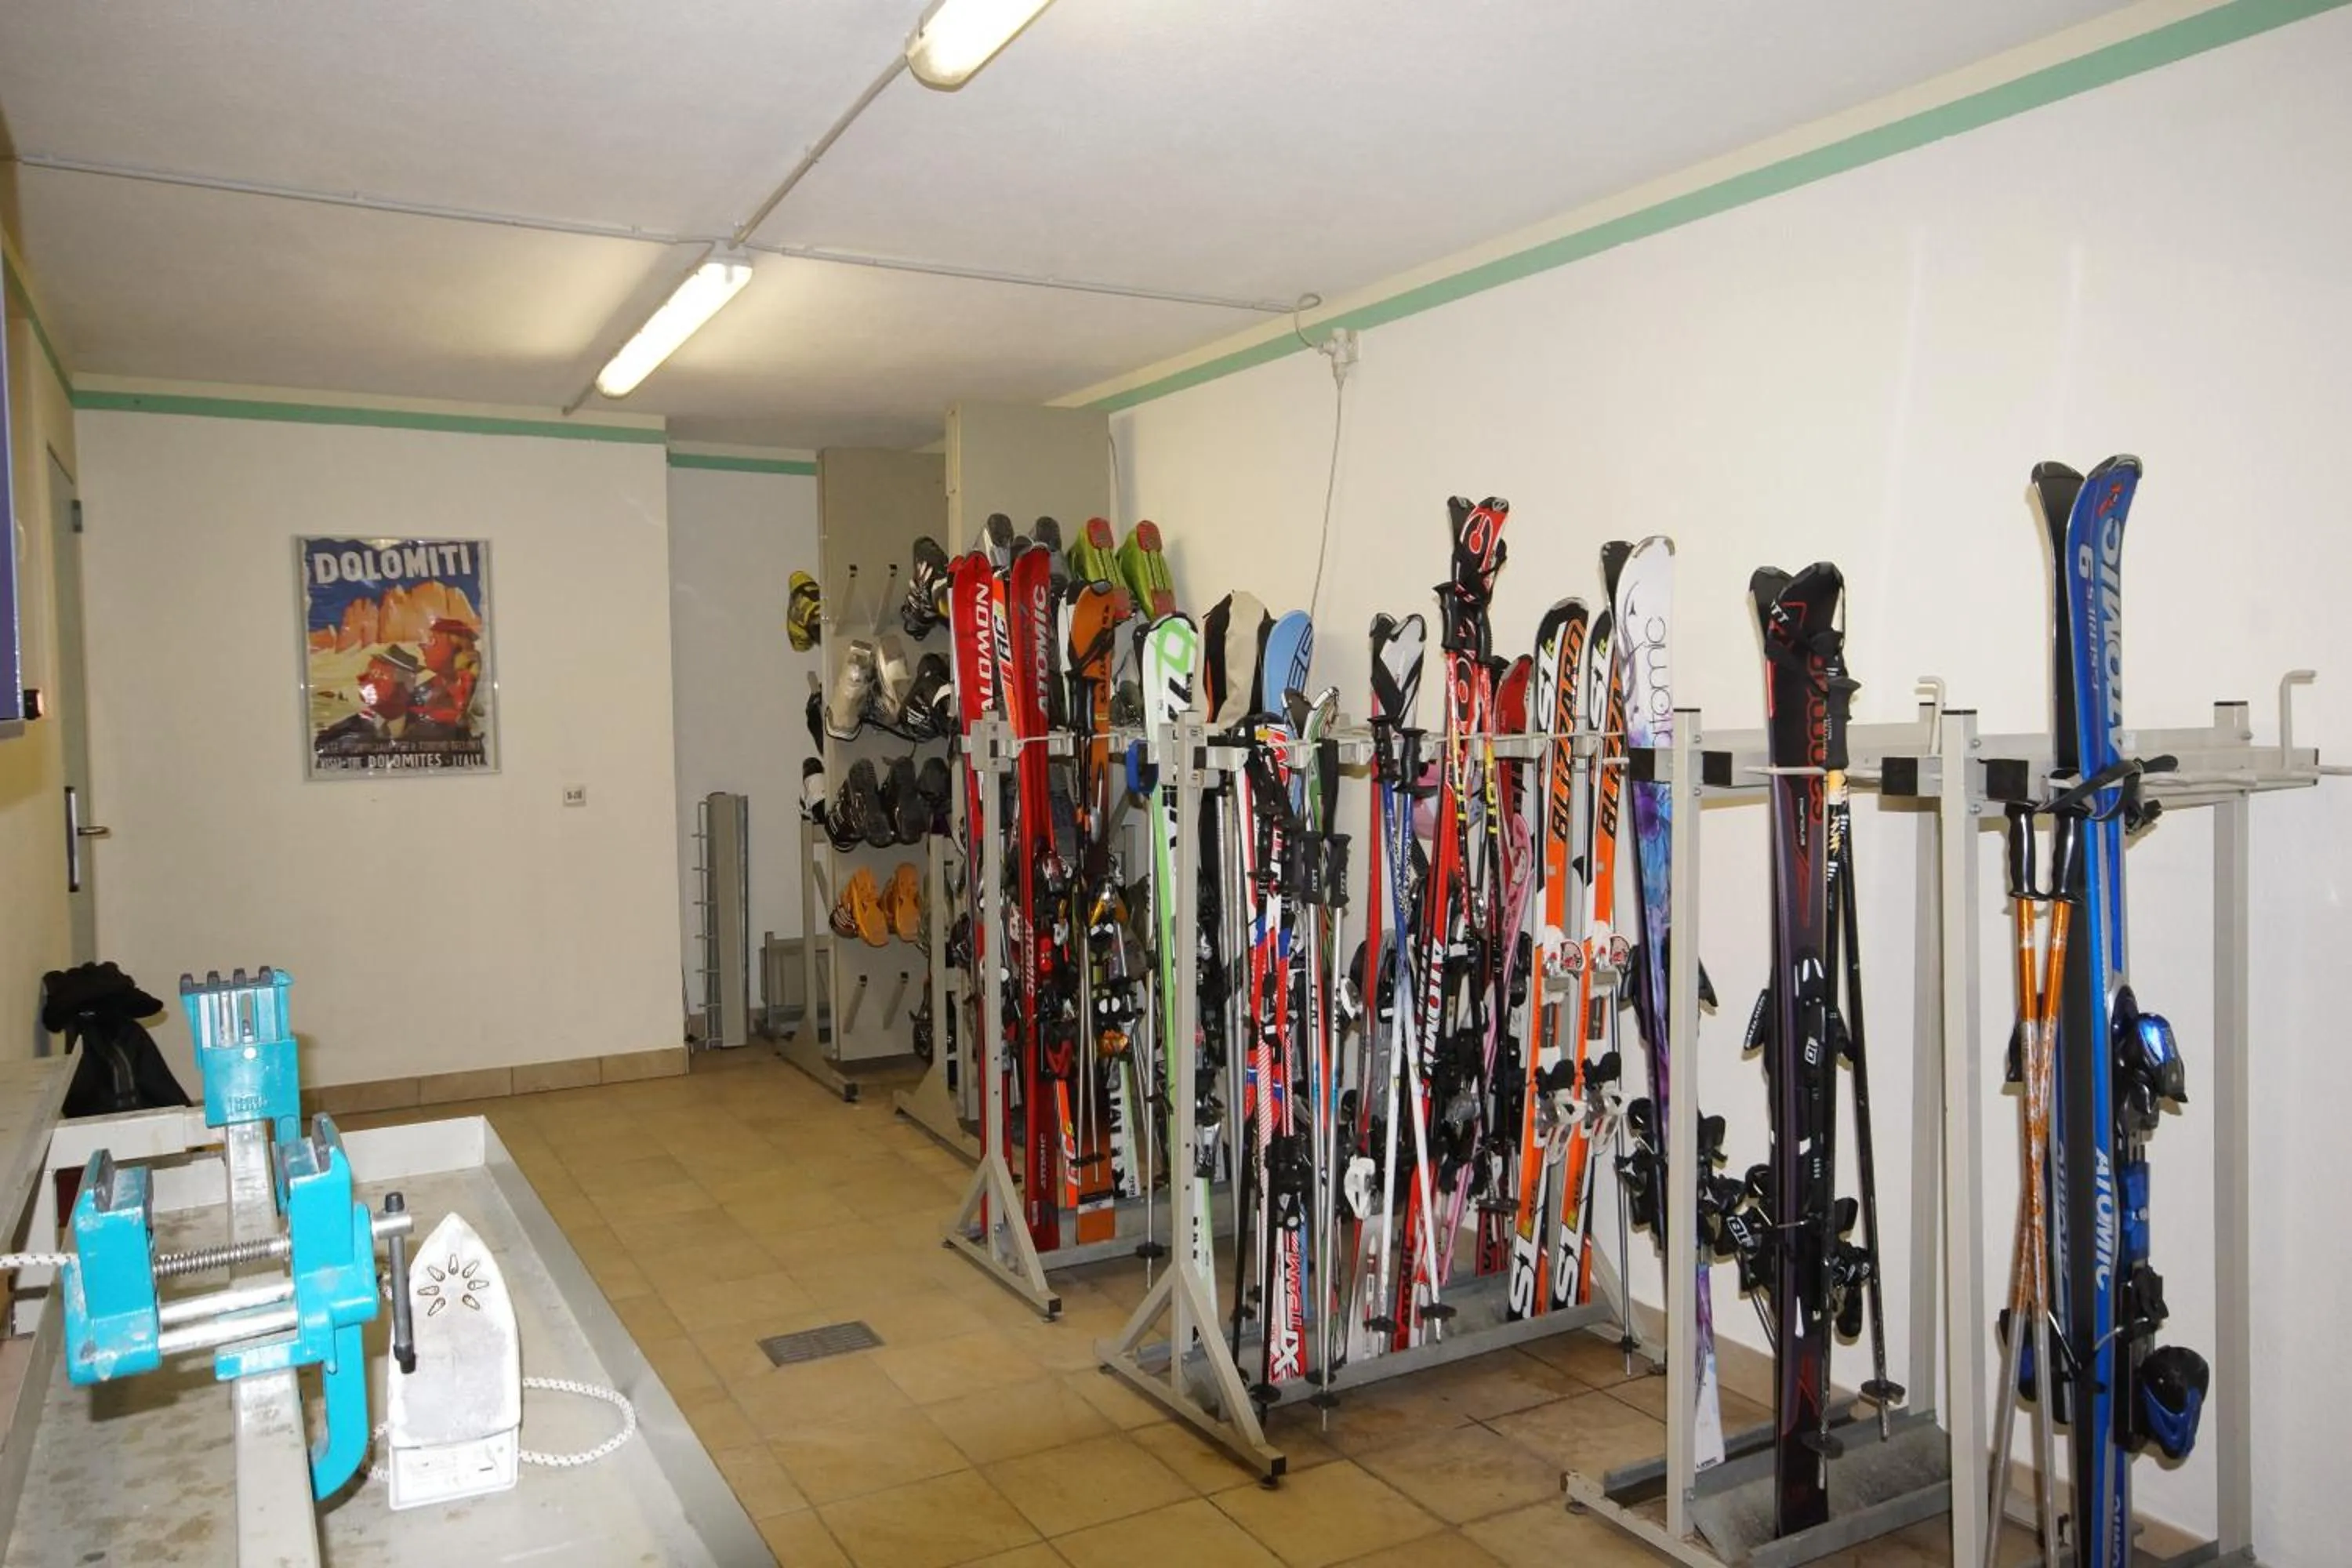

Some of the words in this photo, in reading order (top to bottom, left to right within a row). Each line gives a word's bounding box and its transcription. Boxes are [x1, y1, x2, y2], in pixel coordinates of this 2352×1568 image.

[314, 544, 473, 584] DOLOMITI
[2078, 543, 2094, 581] 9
[975, 582, 994, 711] ALOMON
[1033, 583, 1049, 720] ATOMIC
[2100, 515, 2123, 760] ATOMIC
[368, 753, 441, 768] DOLOMITES
[1601, 677, 1622, 840] BLIZZA
[1423, 938, 1443, 1076] ATOMI
[2095, 1147, 2114, 1292] ATOMIC
[1286, 1251, 1302, 1330] TEAM
